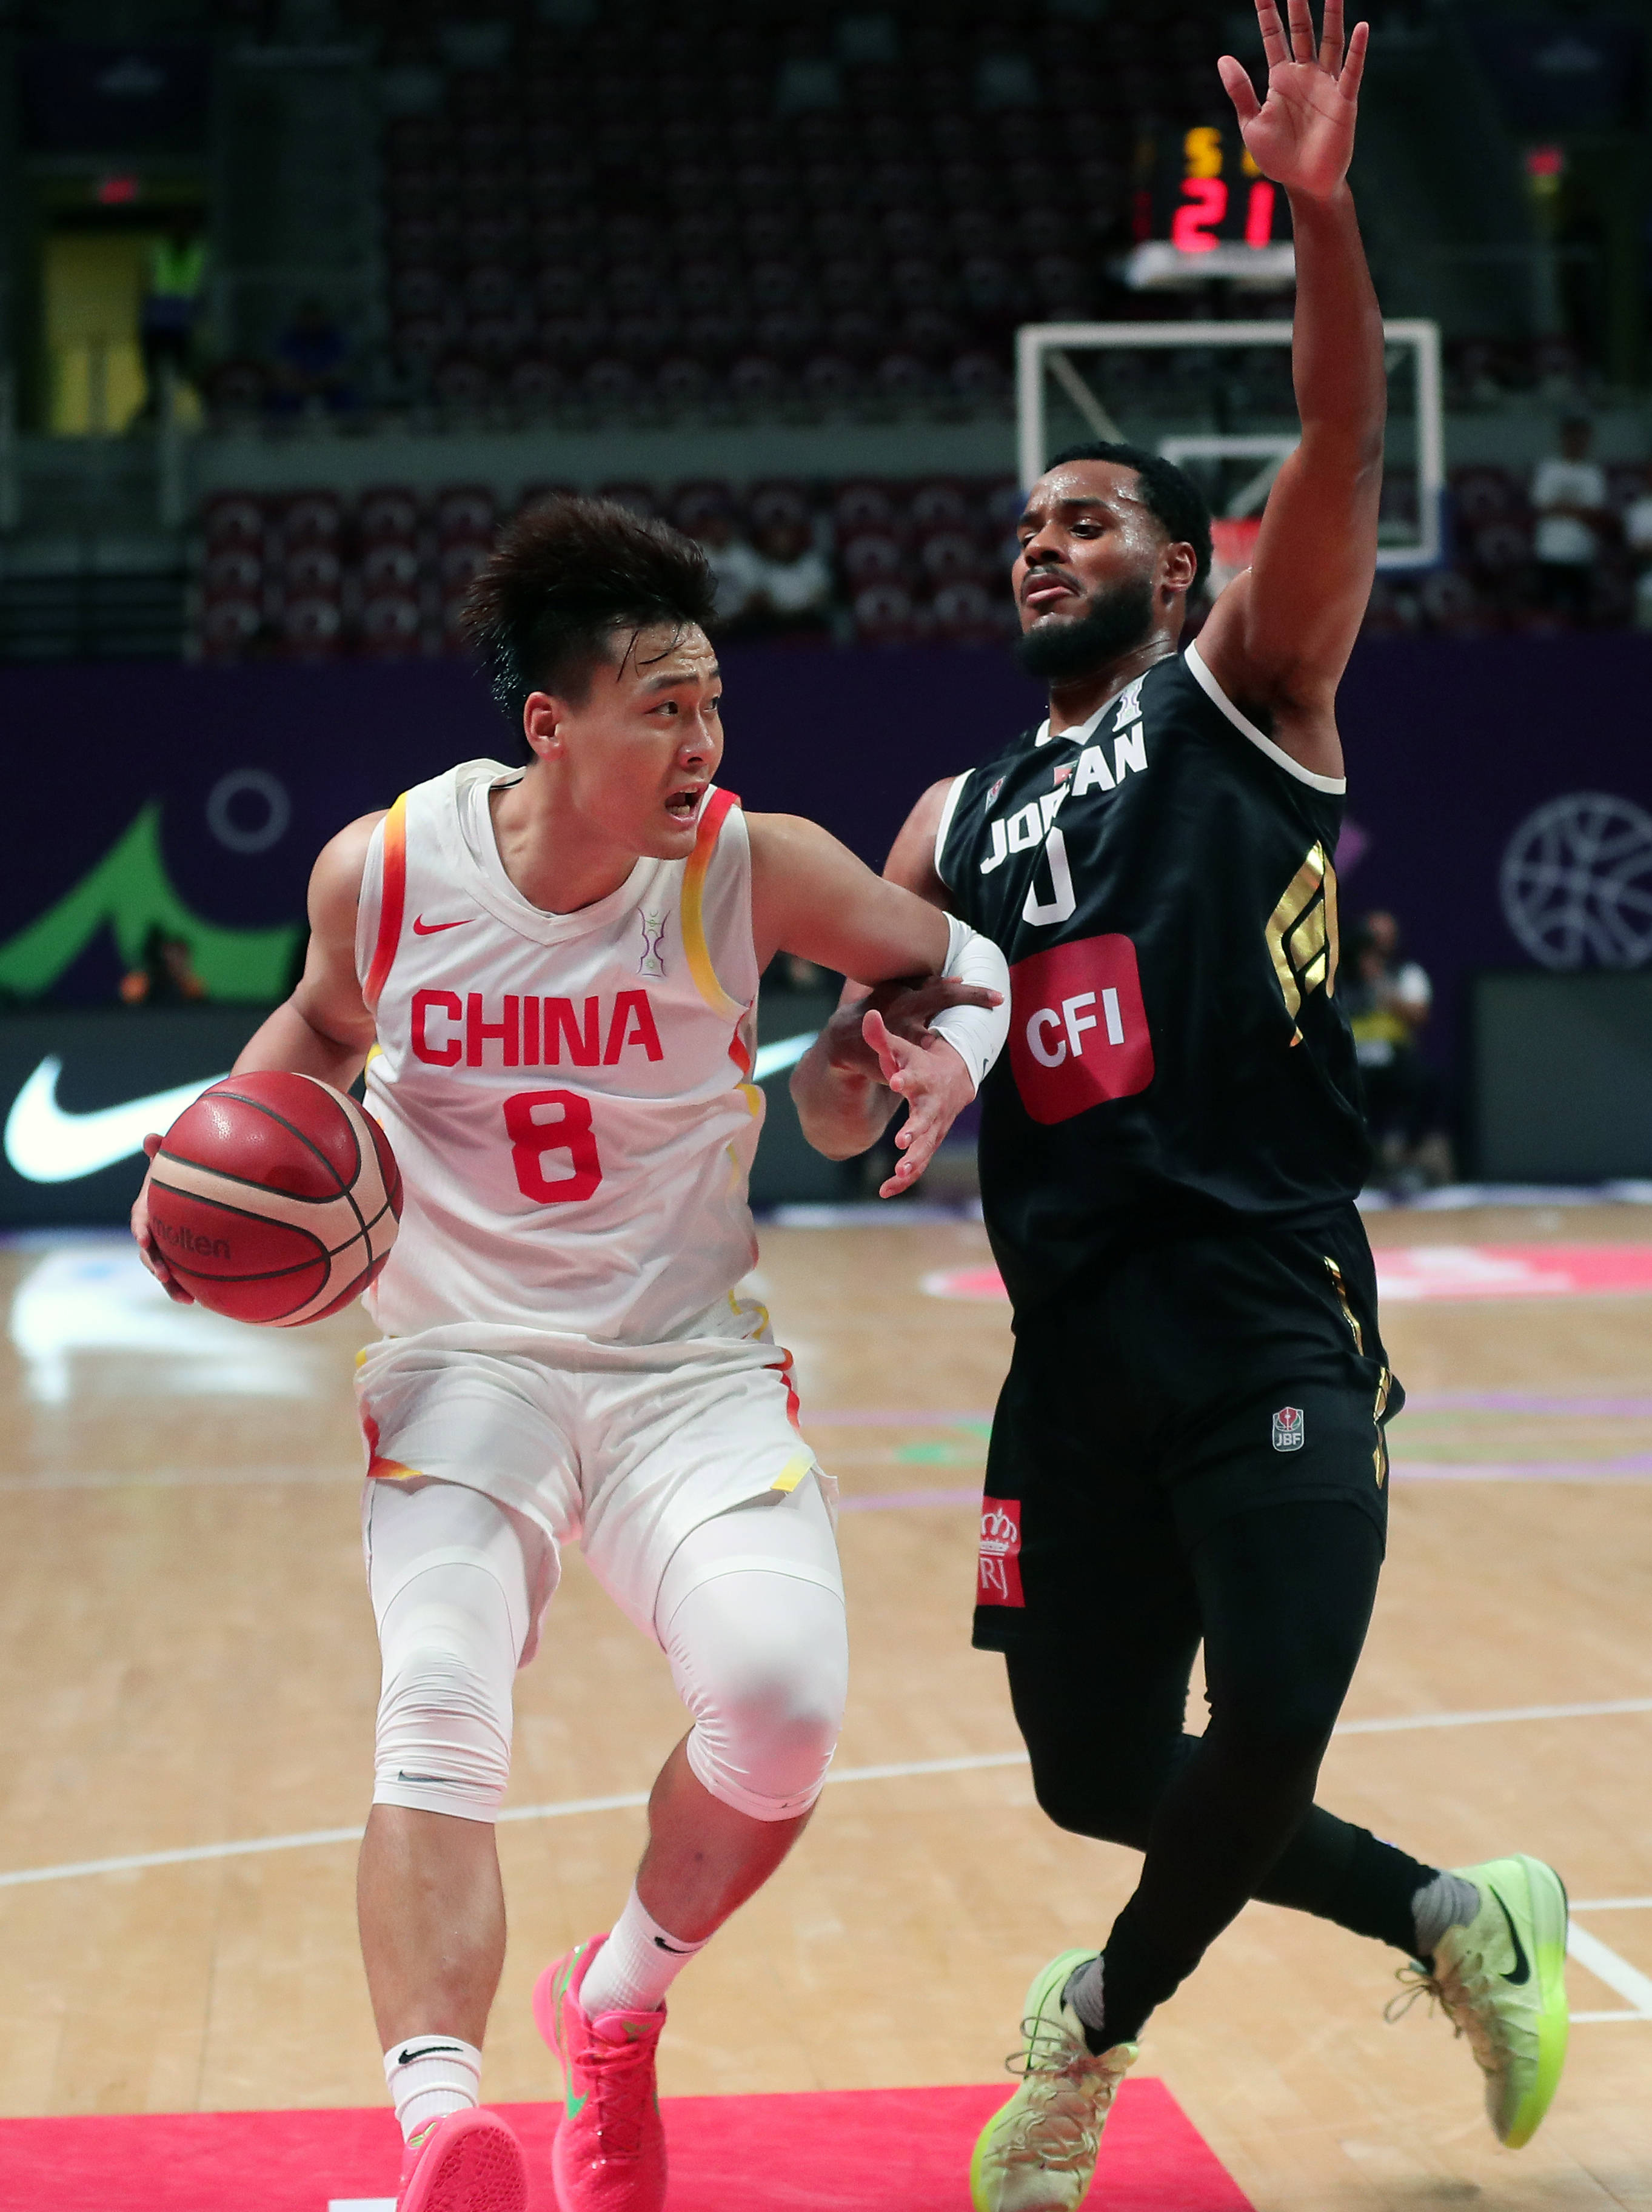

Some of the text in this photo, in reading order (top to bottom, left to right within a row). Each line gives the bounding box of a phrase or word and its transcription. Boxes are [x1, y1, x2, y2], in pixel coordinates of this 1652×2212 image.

[1172, 177, 1275, 252] 21
[411, 989, 664, 1067] CHINA
[1026, 988, 1125, 1068] CFI
[503, 1090, 602, 1204] 8
[151, 1216, 231, 1260] molten
[1276, 1433, 1302, 1447] JBF
